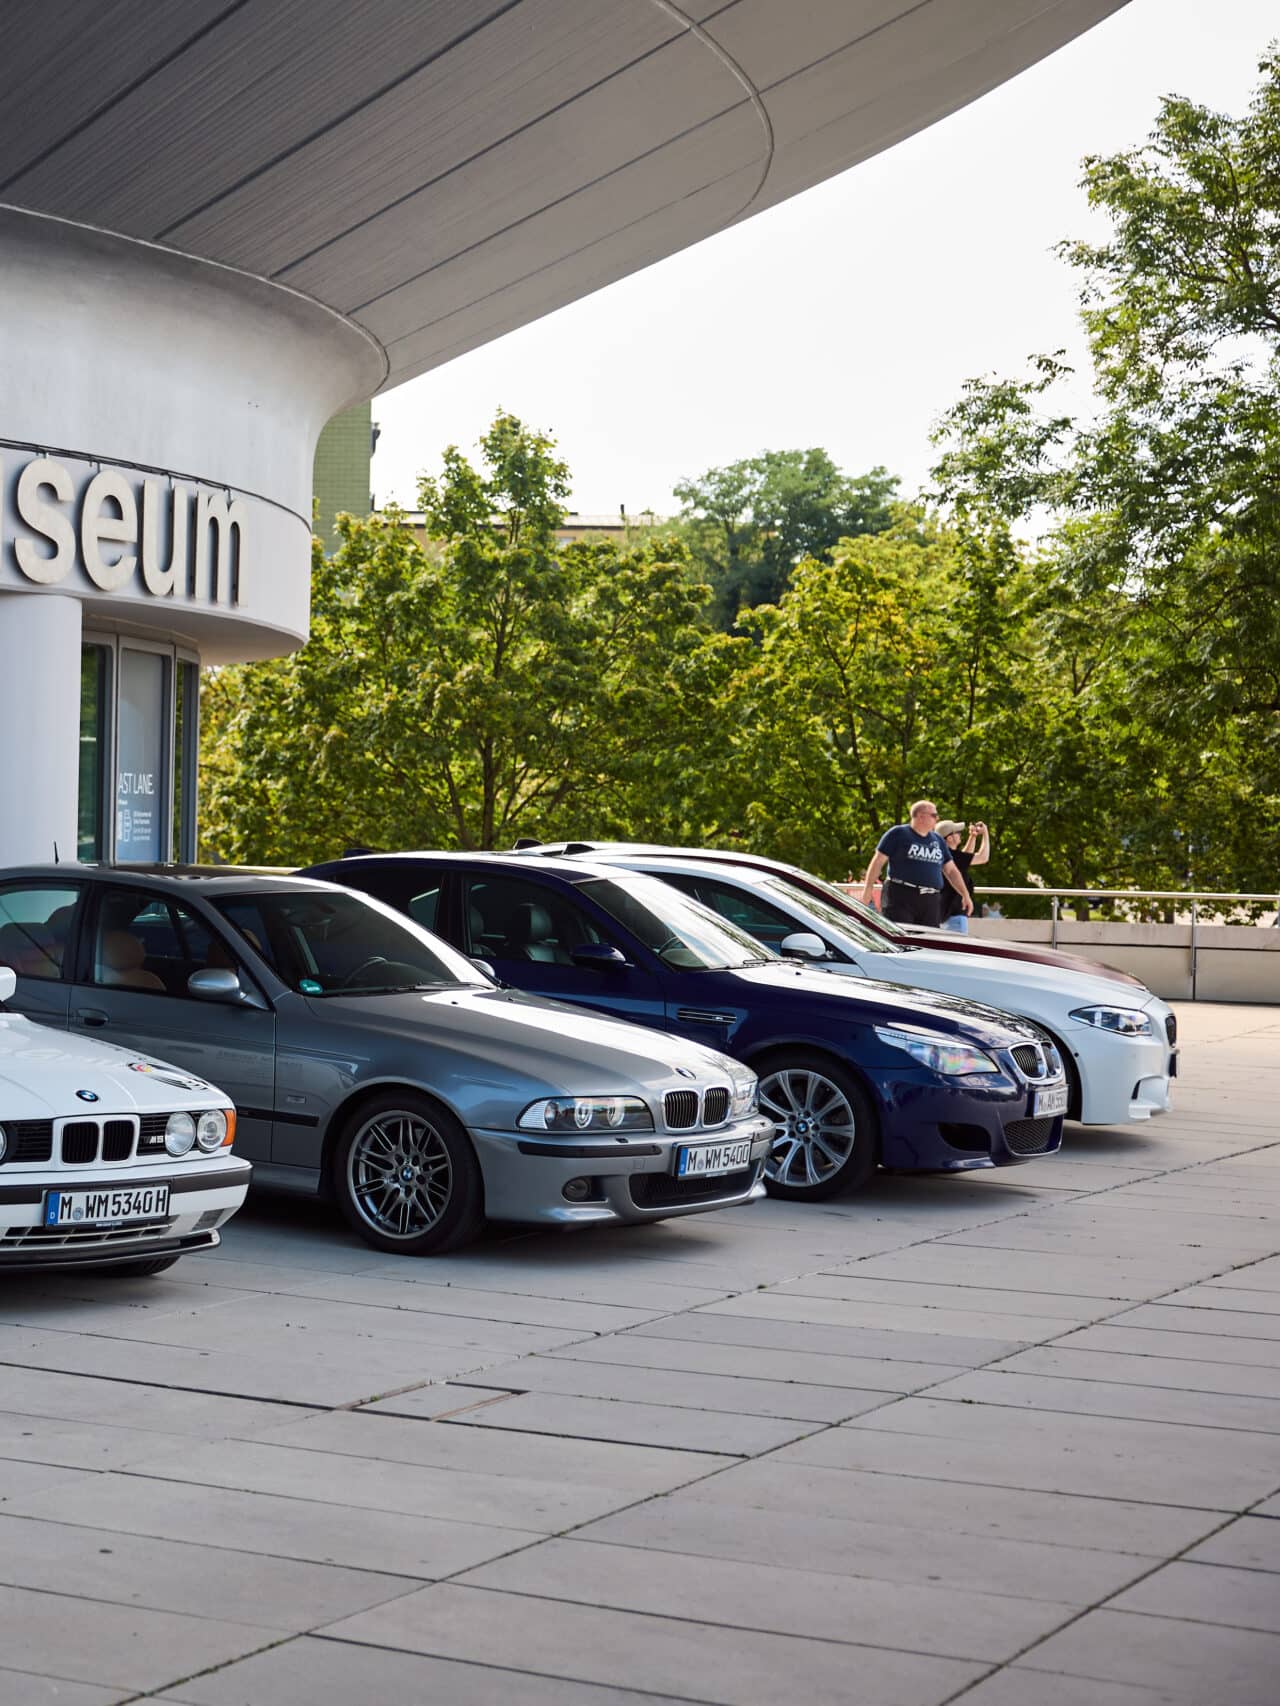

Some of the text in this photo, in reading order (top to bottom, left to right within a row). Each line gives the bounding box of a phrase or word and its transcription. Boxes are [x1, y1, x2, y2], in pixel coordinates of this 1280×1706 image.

[908, 844, 942, 860] RAMS
[688, 1151, 697, 1171] M
[60, 1196, 73, 1219] M
